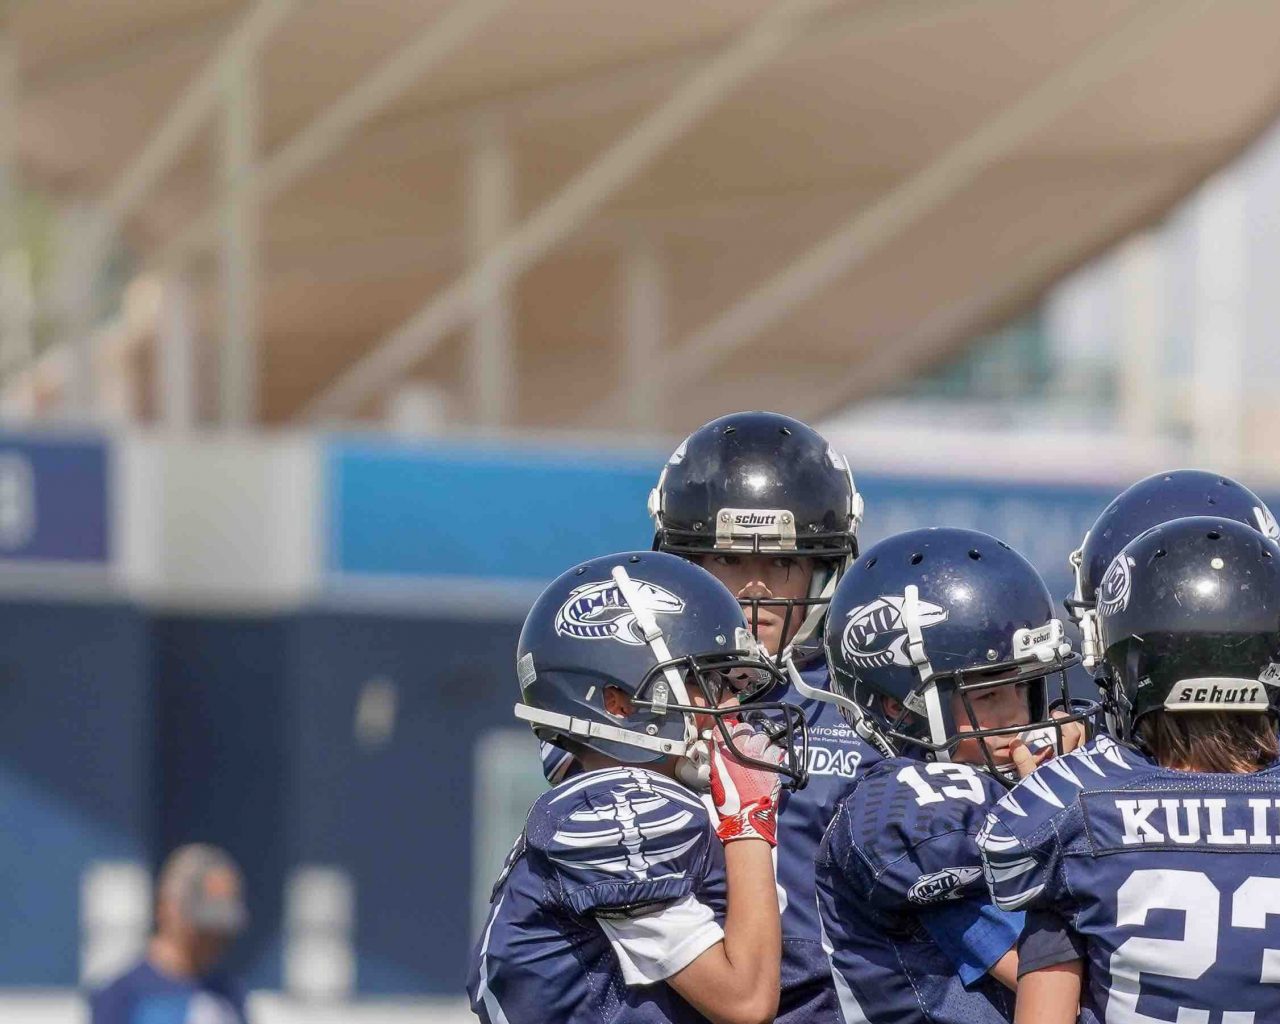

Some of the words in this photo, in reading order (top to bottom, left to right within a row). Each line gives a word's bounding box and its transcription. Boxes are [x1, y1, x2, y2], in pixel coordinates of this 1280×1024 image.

[735, 513, 776, 525] schutt
[1179, 685, 1259, 704] schutt
[896, 762, 986, 807] 13
